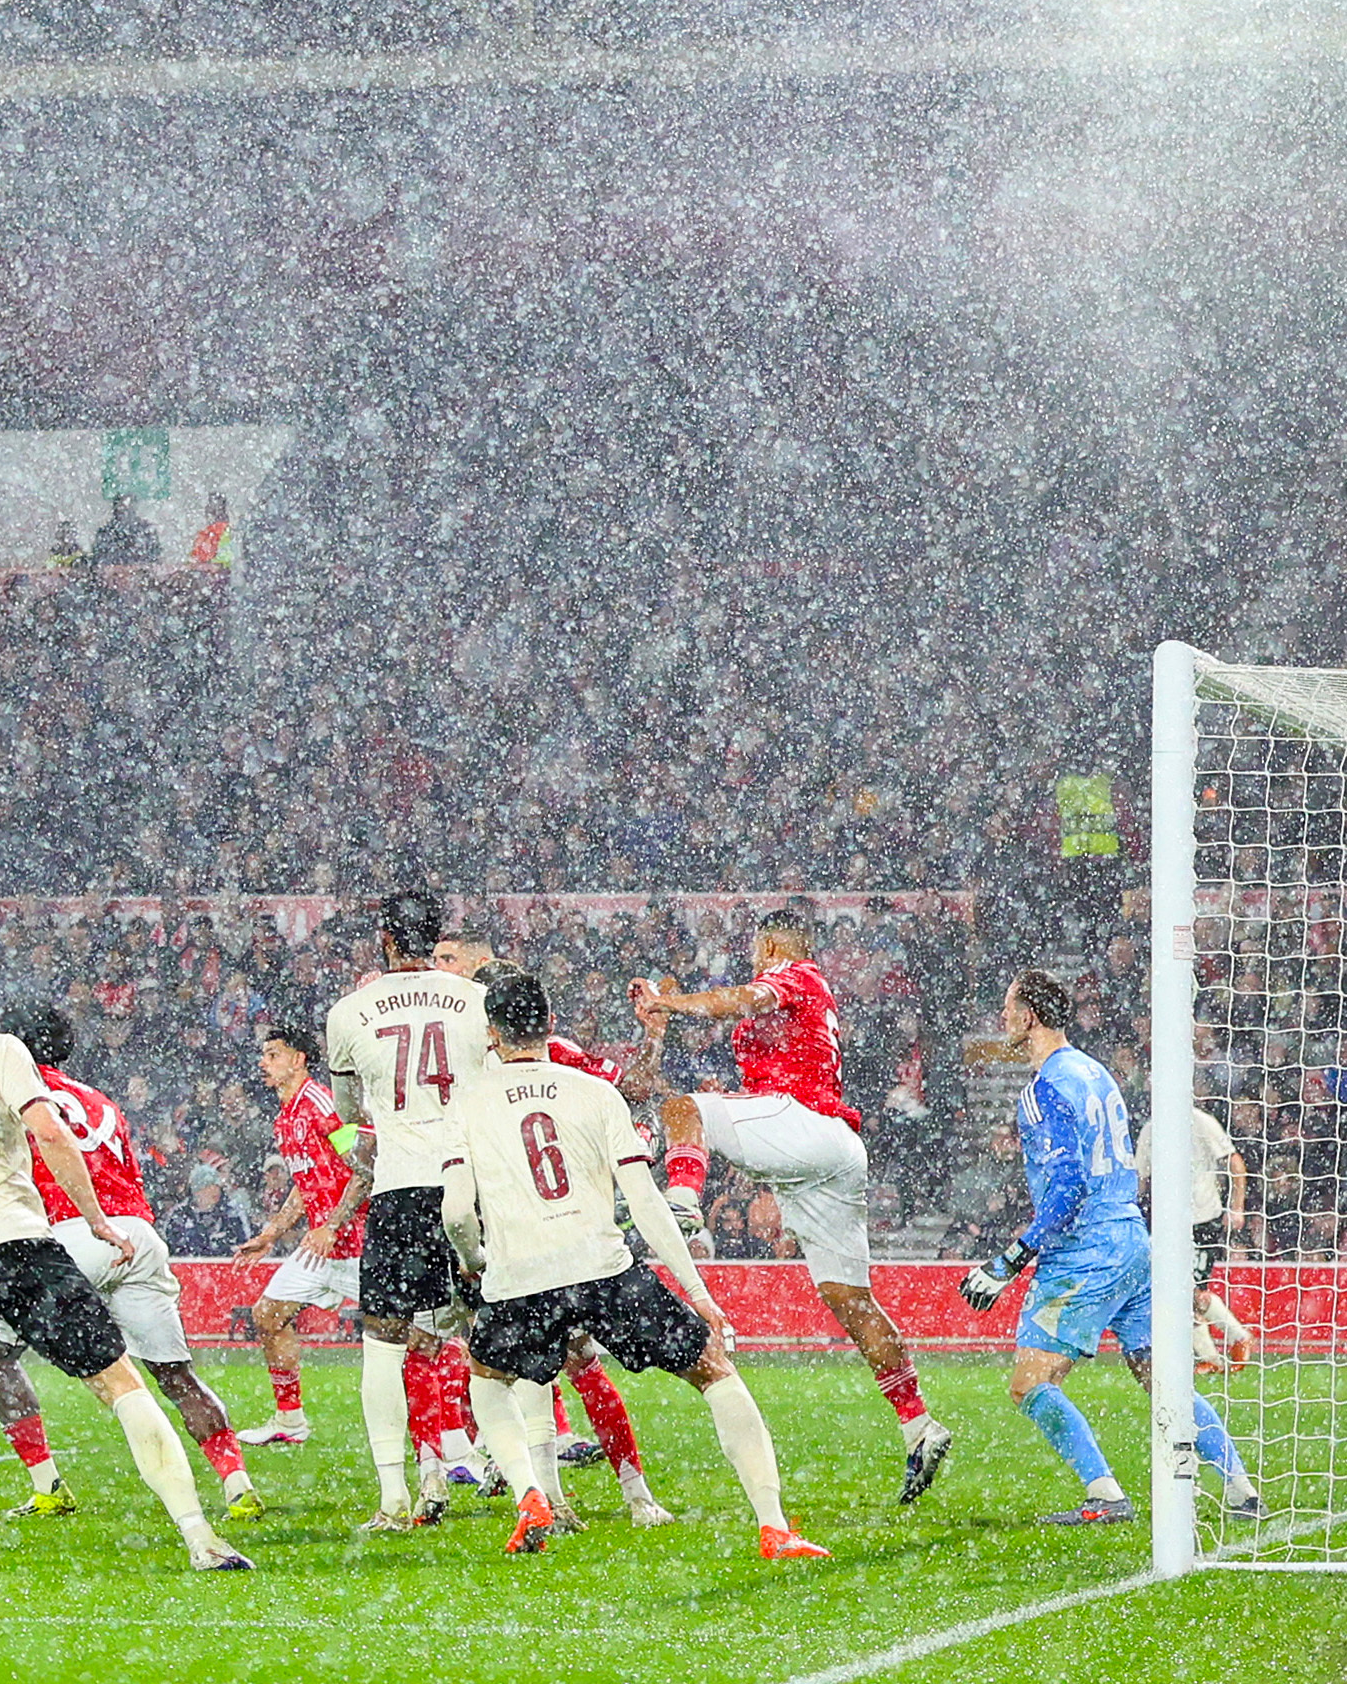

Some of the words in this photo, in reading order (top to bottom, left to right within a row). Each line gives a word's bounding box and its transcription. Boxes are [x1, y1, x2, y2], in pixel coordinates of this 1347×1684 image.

[359, 1012, 373, 1026] J.
[375, 991, 466, 1015] BRUMADO
[375, 1021, 454, 1111] 74
[505, 1082, 558, 1104] ERLIĆ
[520, 1112, 570, 1201] 6
